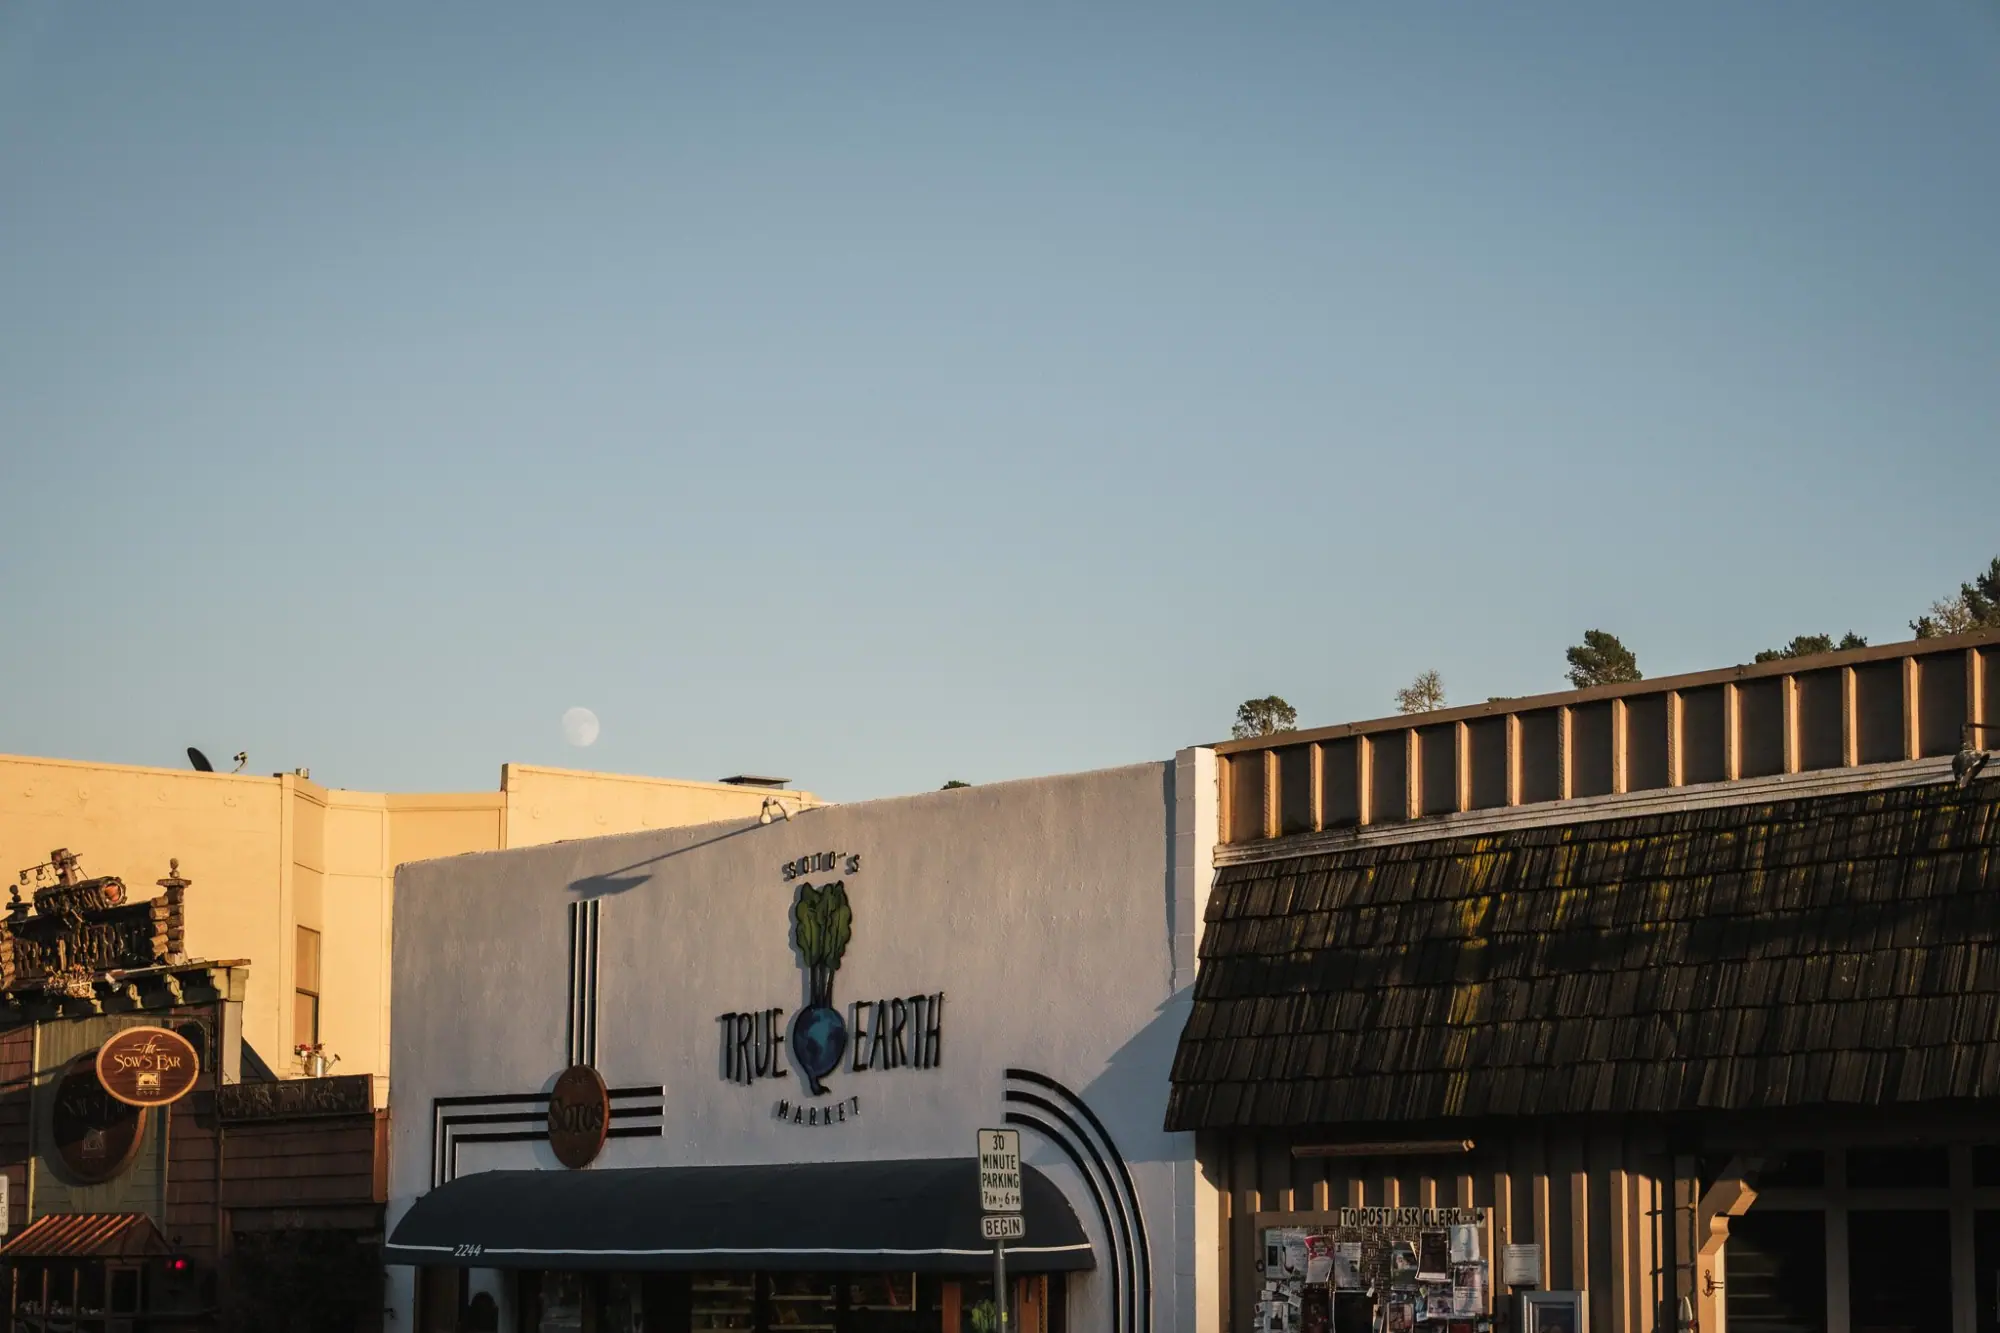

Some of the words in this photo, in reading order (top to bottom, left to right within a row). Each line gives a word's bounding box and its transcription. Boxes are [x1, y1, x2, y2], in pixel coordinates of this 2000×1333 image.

[134, 1034, 163, 1054] The
[720, 1008, 787, 1086] TRUE
[852, 992, 945, 1073] EARTH
[156, 1054, 181, 1072] EAR
[777, 1096, 861, 1126] MARKET
[993, 1135, 1005, 1150] 30
[982, 1154, 1017, 1170] MINUTE
[982, 1173, 1020, 1189] PARKING
[1342, 1209, 1357, 1226] TO
[1361, 1208, 1392, 1226] POST
[1397, 1208, 1420, 1226] ASK
[985, 1220, 1021, 1236] BEGIN
[454, 1243, 482, 1257] 2244
